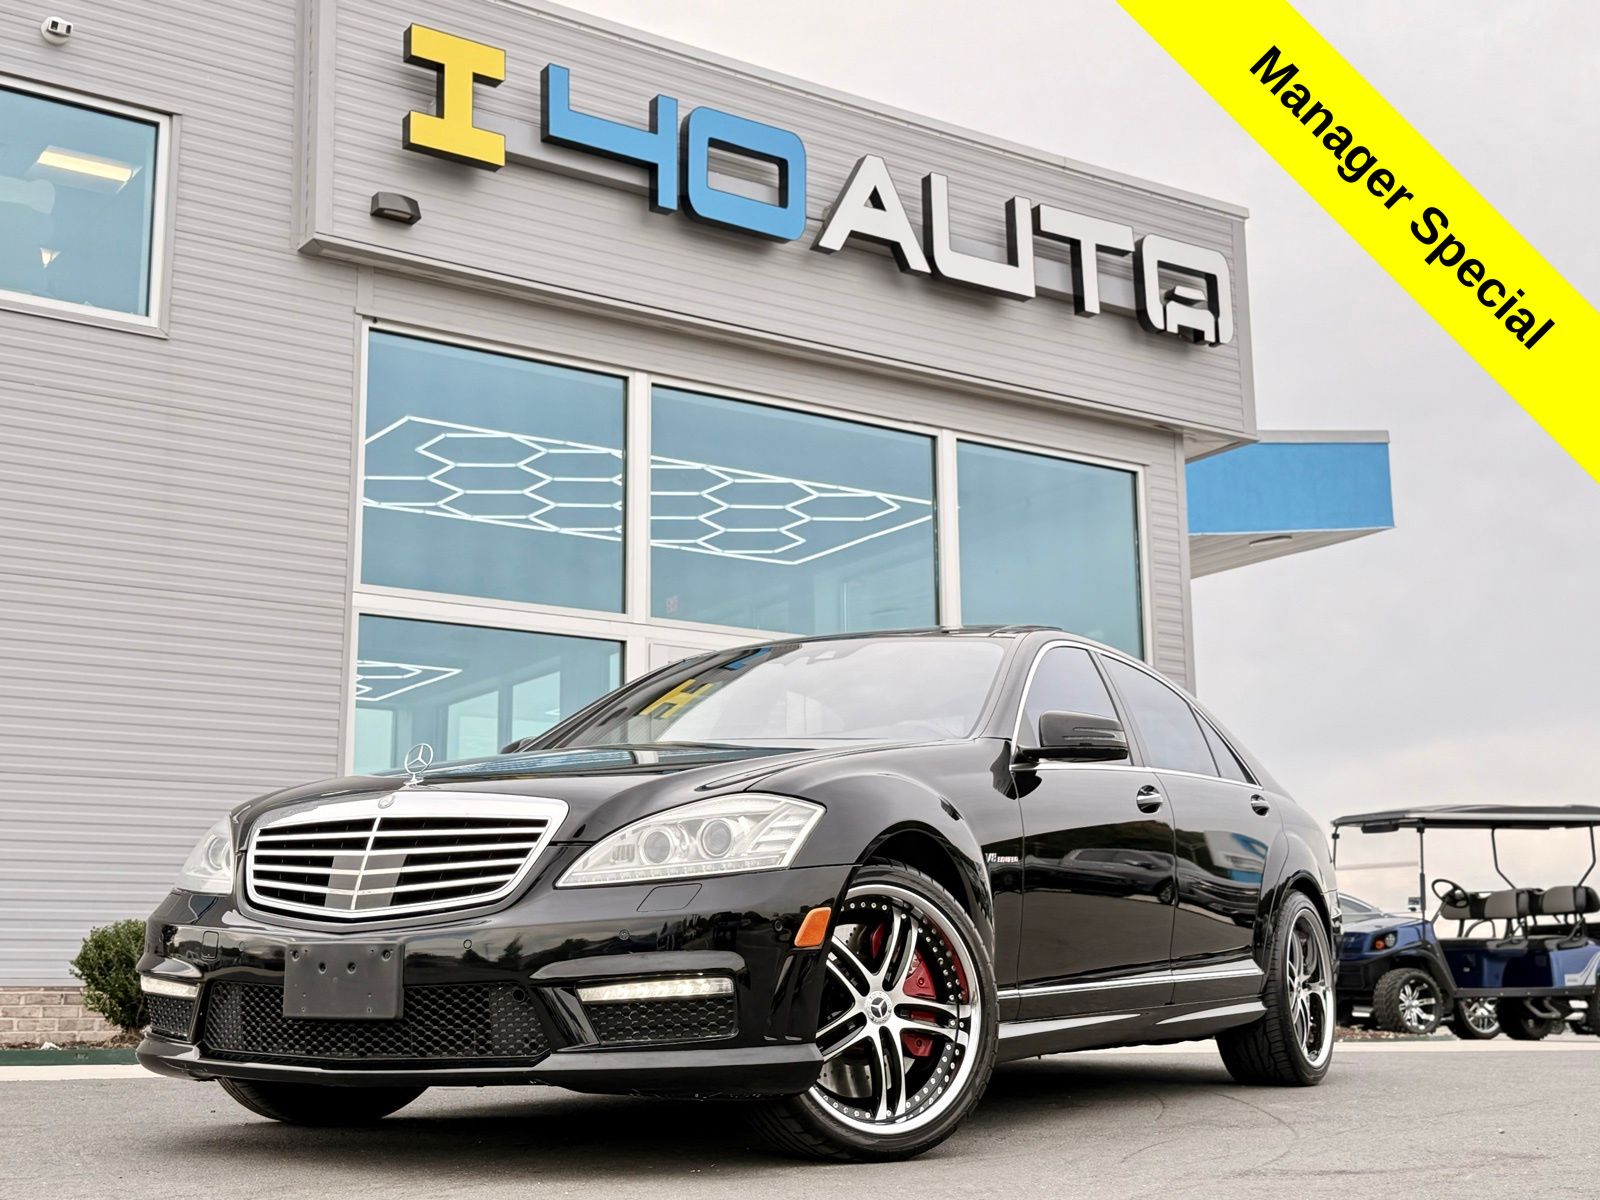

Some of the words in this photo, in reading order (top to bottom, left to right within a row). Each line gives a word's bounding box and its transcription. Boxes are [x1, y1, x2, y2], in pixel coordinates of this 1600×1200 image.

[403, 23, 506, 171] I
[541, 63, 807, 243] 40
[811, 153, 1234, 347] AUTO
